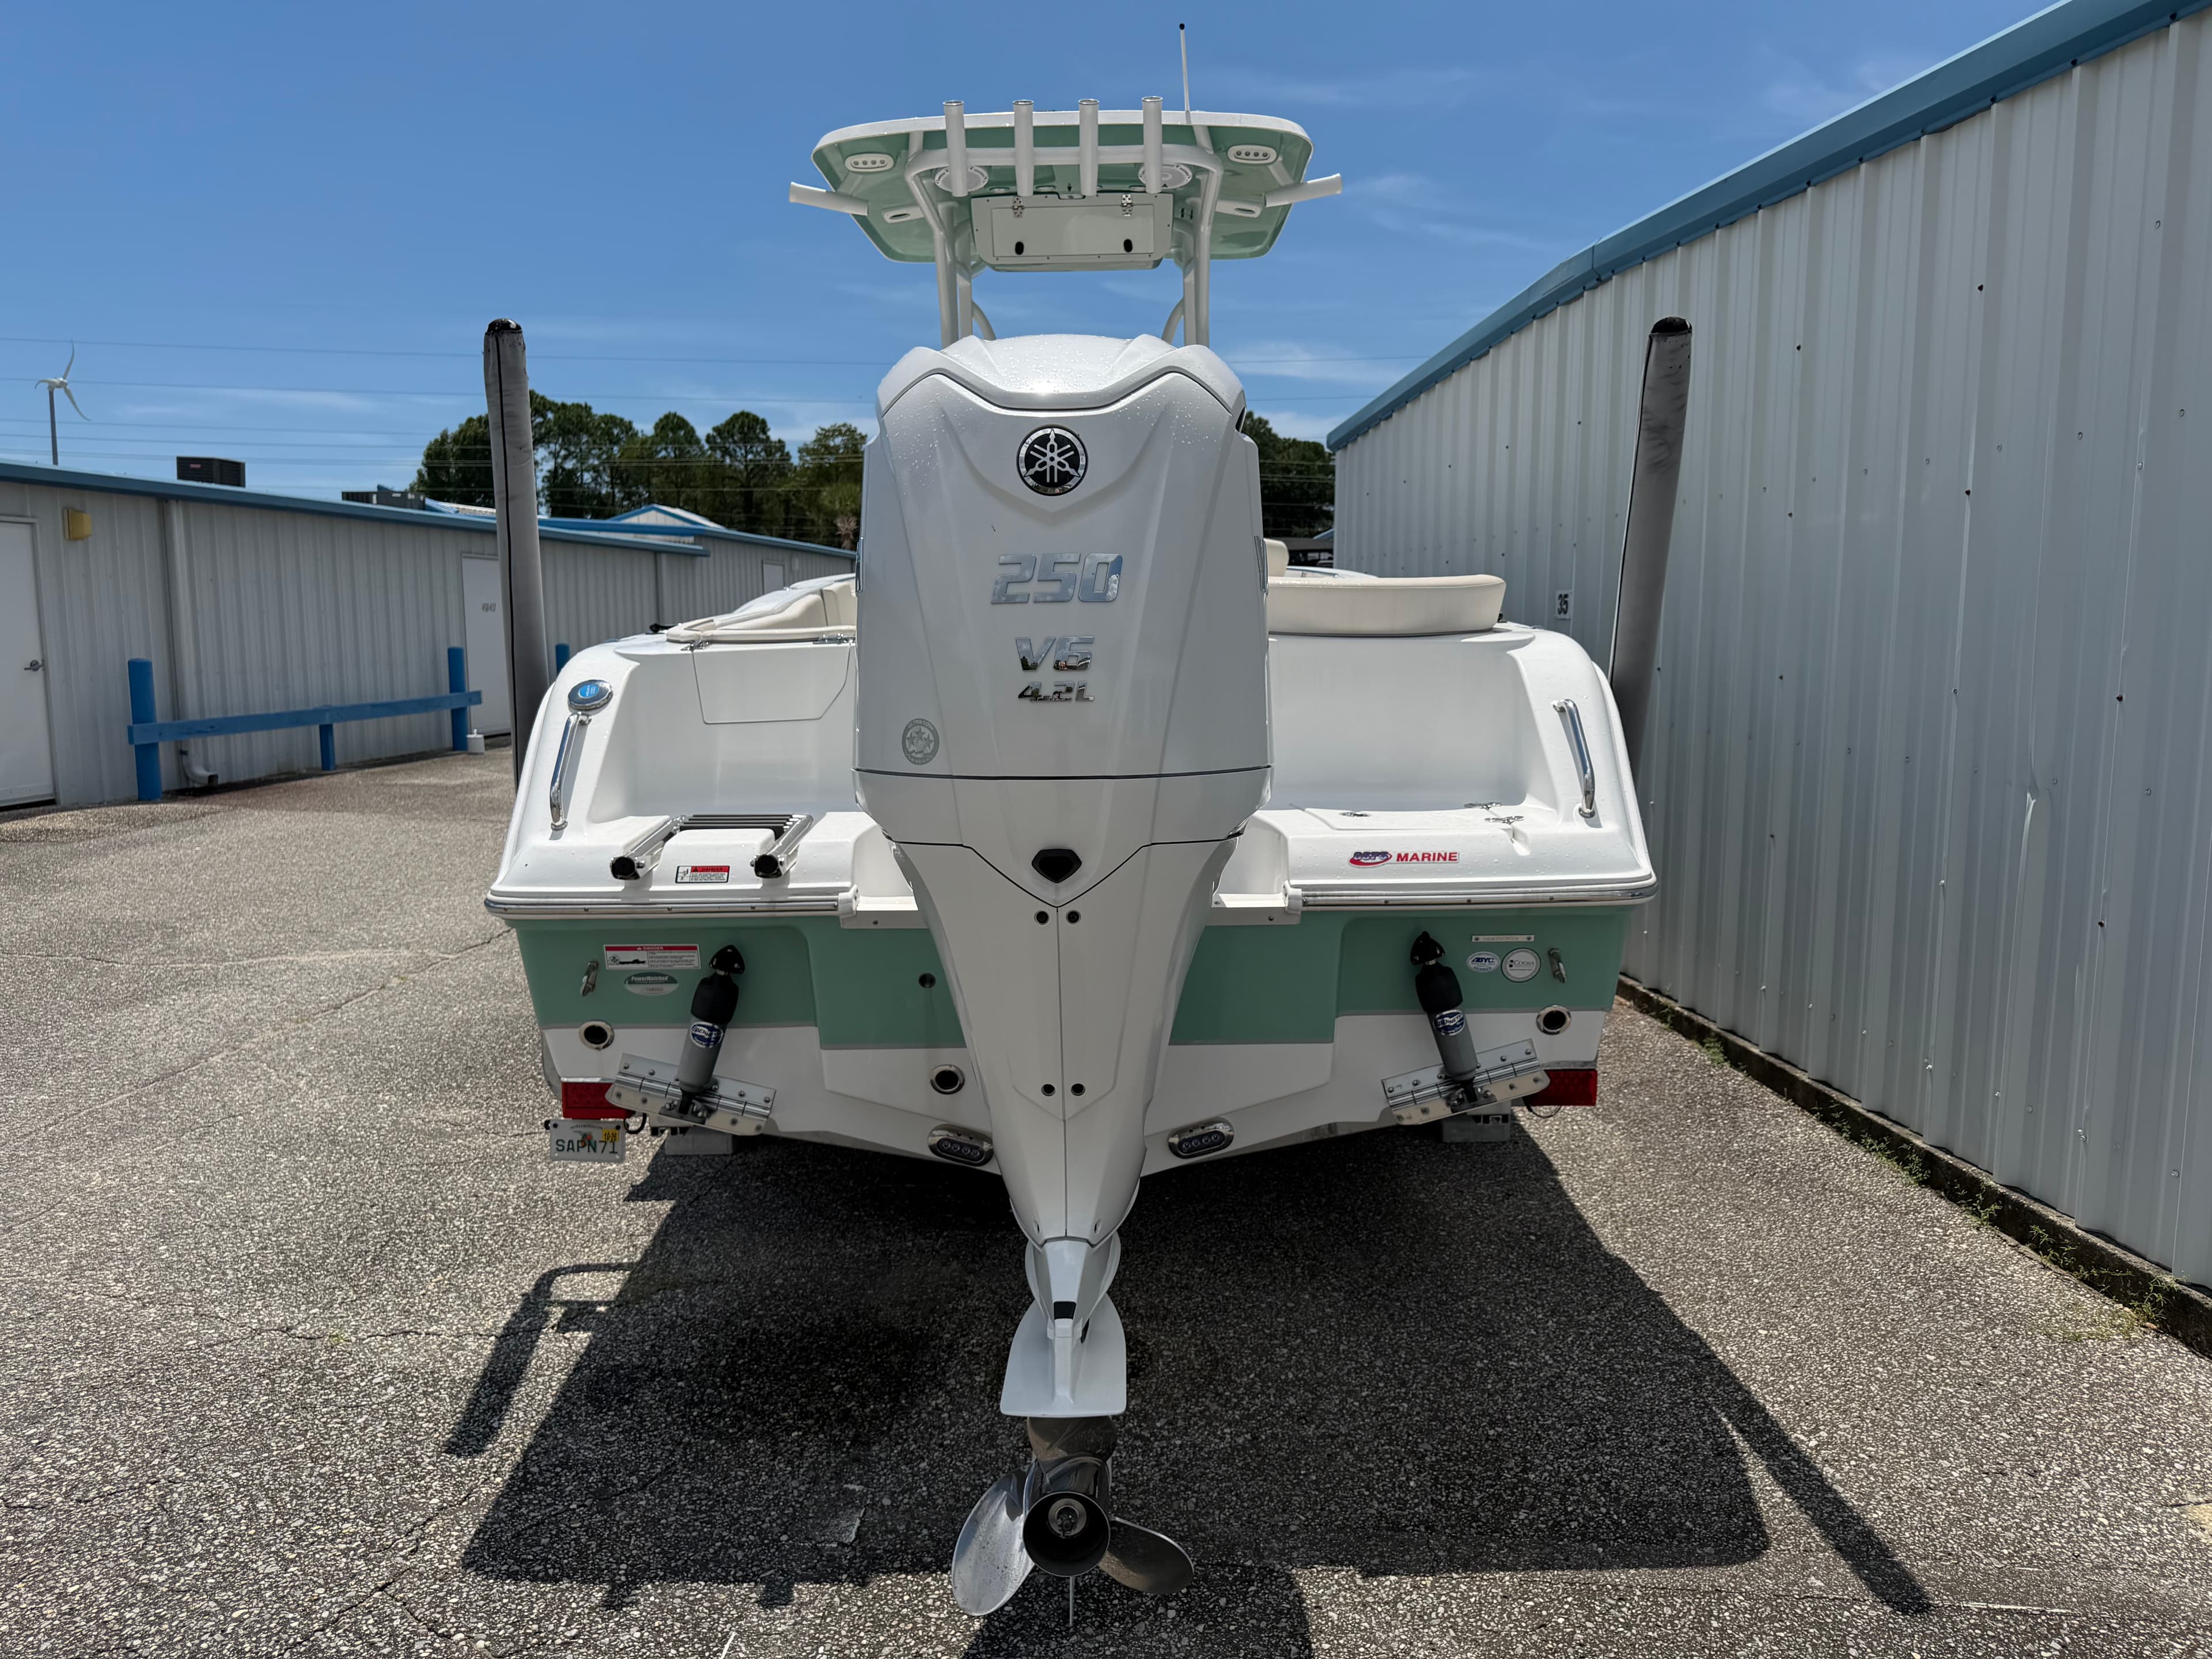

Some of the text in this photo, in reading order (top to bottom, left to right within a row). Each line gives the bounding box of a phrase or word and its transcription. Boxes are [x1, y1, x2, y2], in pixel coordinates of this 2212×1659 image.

[991, 553, 1123, 604] 250
[1558, 593, 1569, 615] 35
[1016, 636, 1094, 672] V6
[1018, 681, 1094, 703] 4.2L
[1396, 852, 1458, 862] MARINE
[556, 1139, 618, 1154] SAPN71
